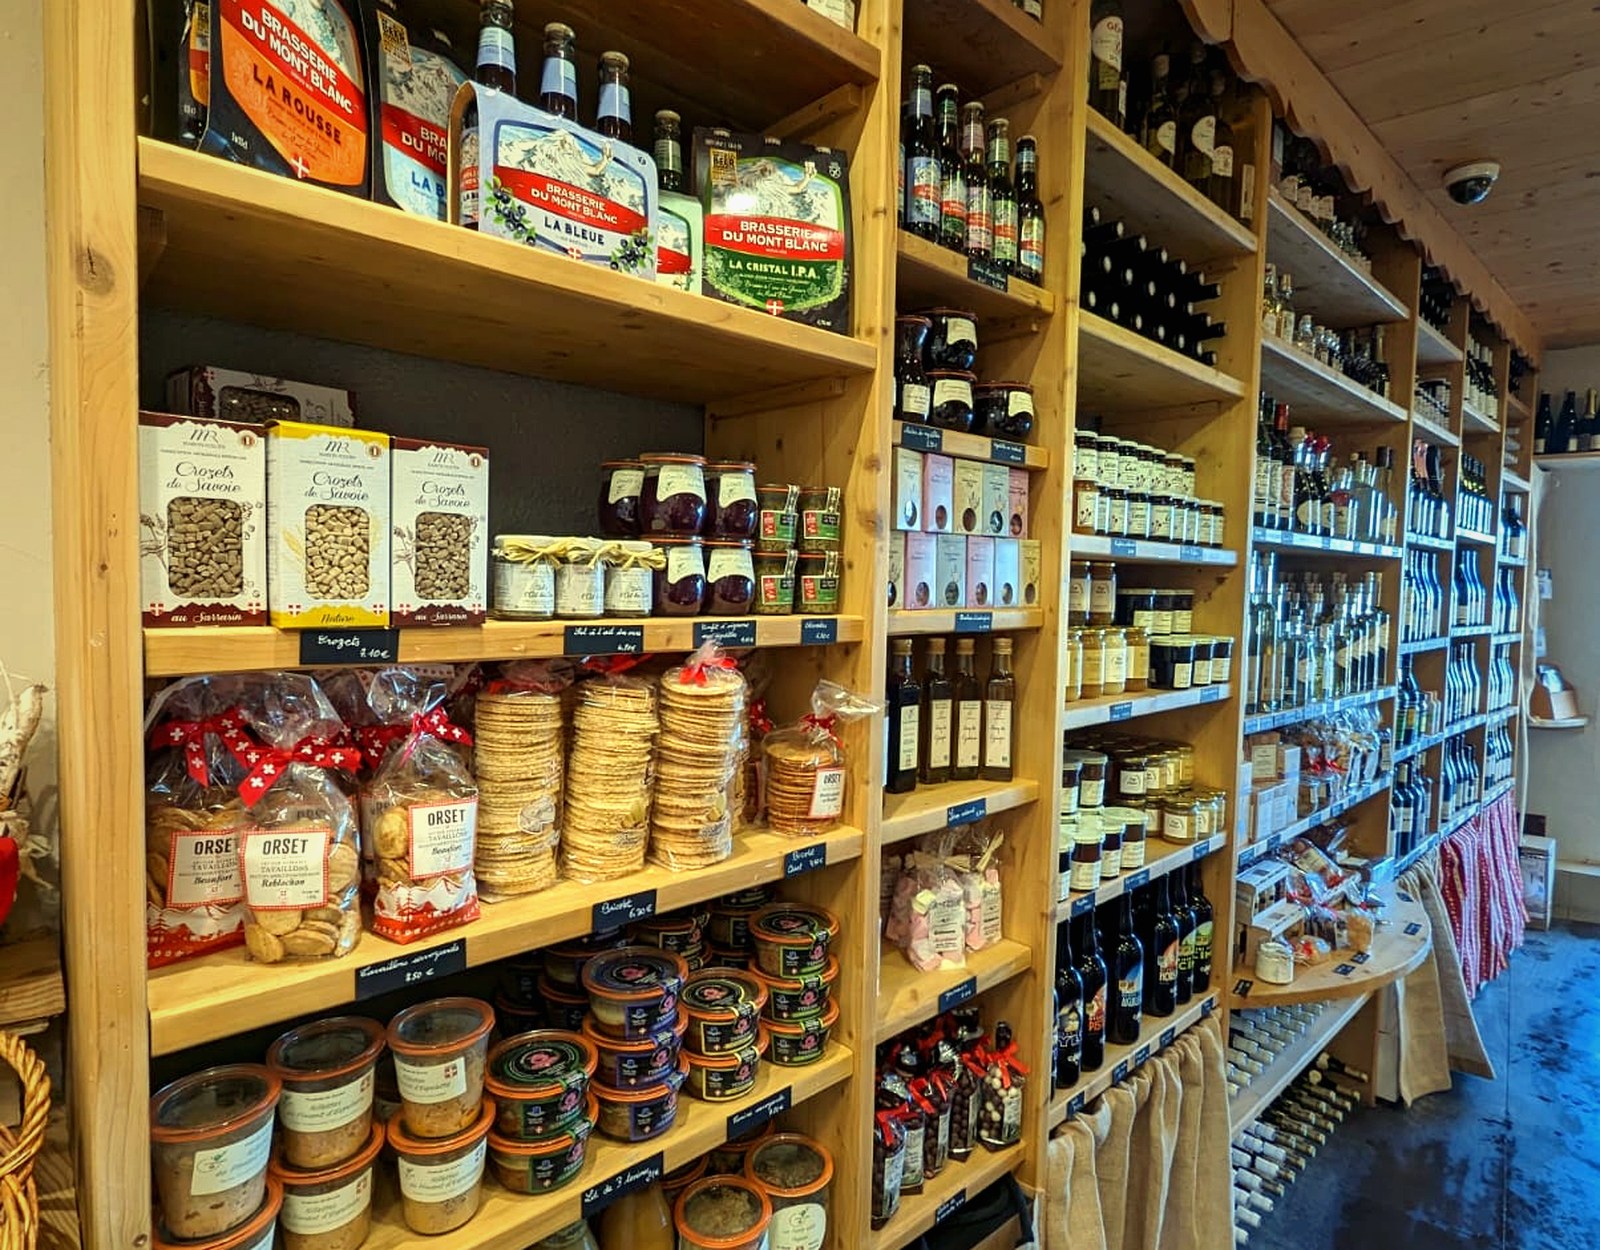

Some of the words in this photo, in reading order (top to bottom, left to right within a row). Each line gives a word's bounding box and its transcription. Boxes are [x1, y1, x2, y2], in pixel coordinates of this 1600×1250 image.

[261, 7, 337, 85] BRASSERIE
[241, 10, 266, 41] DU
[269, 35, 309, 78] MONT
[310, 69, 353, 114] BLANC
[253, 63, 276, 96] LA
[282, 85, 342, 146] ROUSSE
[401, 131, 424, 153] DU
[411, 171, 431, 192] LA
[531, 188, 549, 201] DU
[551, 194, 581, 212] MONT
[582, 203, 618, 225] BLANC
[546, 183, 606, 211] BRASSERIE
[544, 217, 562, 232] LA
[565, 222, 605, 246] BLEUE
[740, 220, 813, 239] BRASSERIE
[722, 230, 744, 243] DU
[746, 234, 782, 248] MONT
[784, 239, 828, 252] BLANC
[729, 259, 743, 270] LA
[746, 262, 788, 276] CRISTAL
[175, 461, 235, 480] Crozets
[312, 471, 363, 488] Crozets
[166, 477, 182, 489] de
[185, 478, 241, 493] Savoie
[304, 487, 318, 498] de
[321, 487, 369, 500] Savoie
[421, 480, 465, 495] Crozets
[428, 495, 470, 507] Savoie
[320, 612, 356, 624] Nature
[427, 809, 467, 826] ORSET
[262, 839, 309, 855] ORSET
[262, 879, 306, 888] Reblochon
